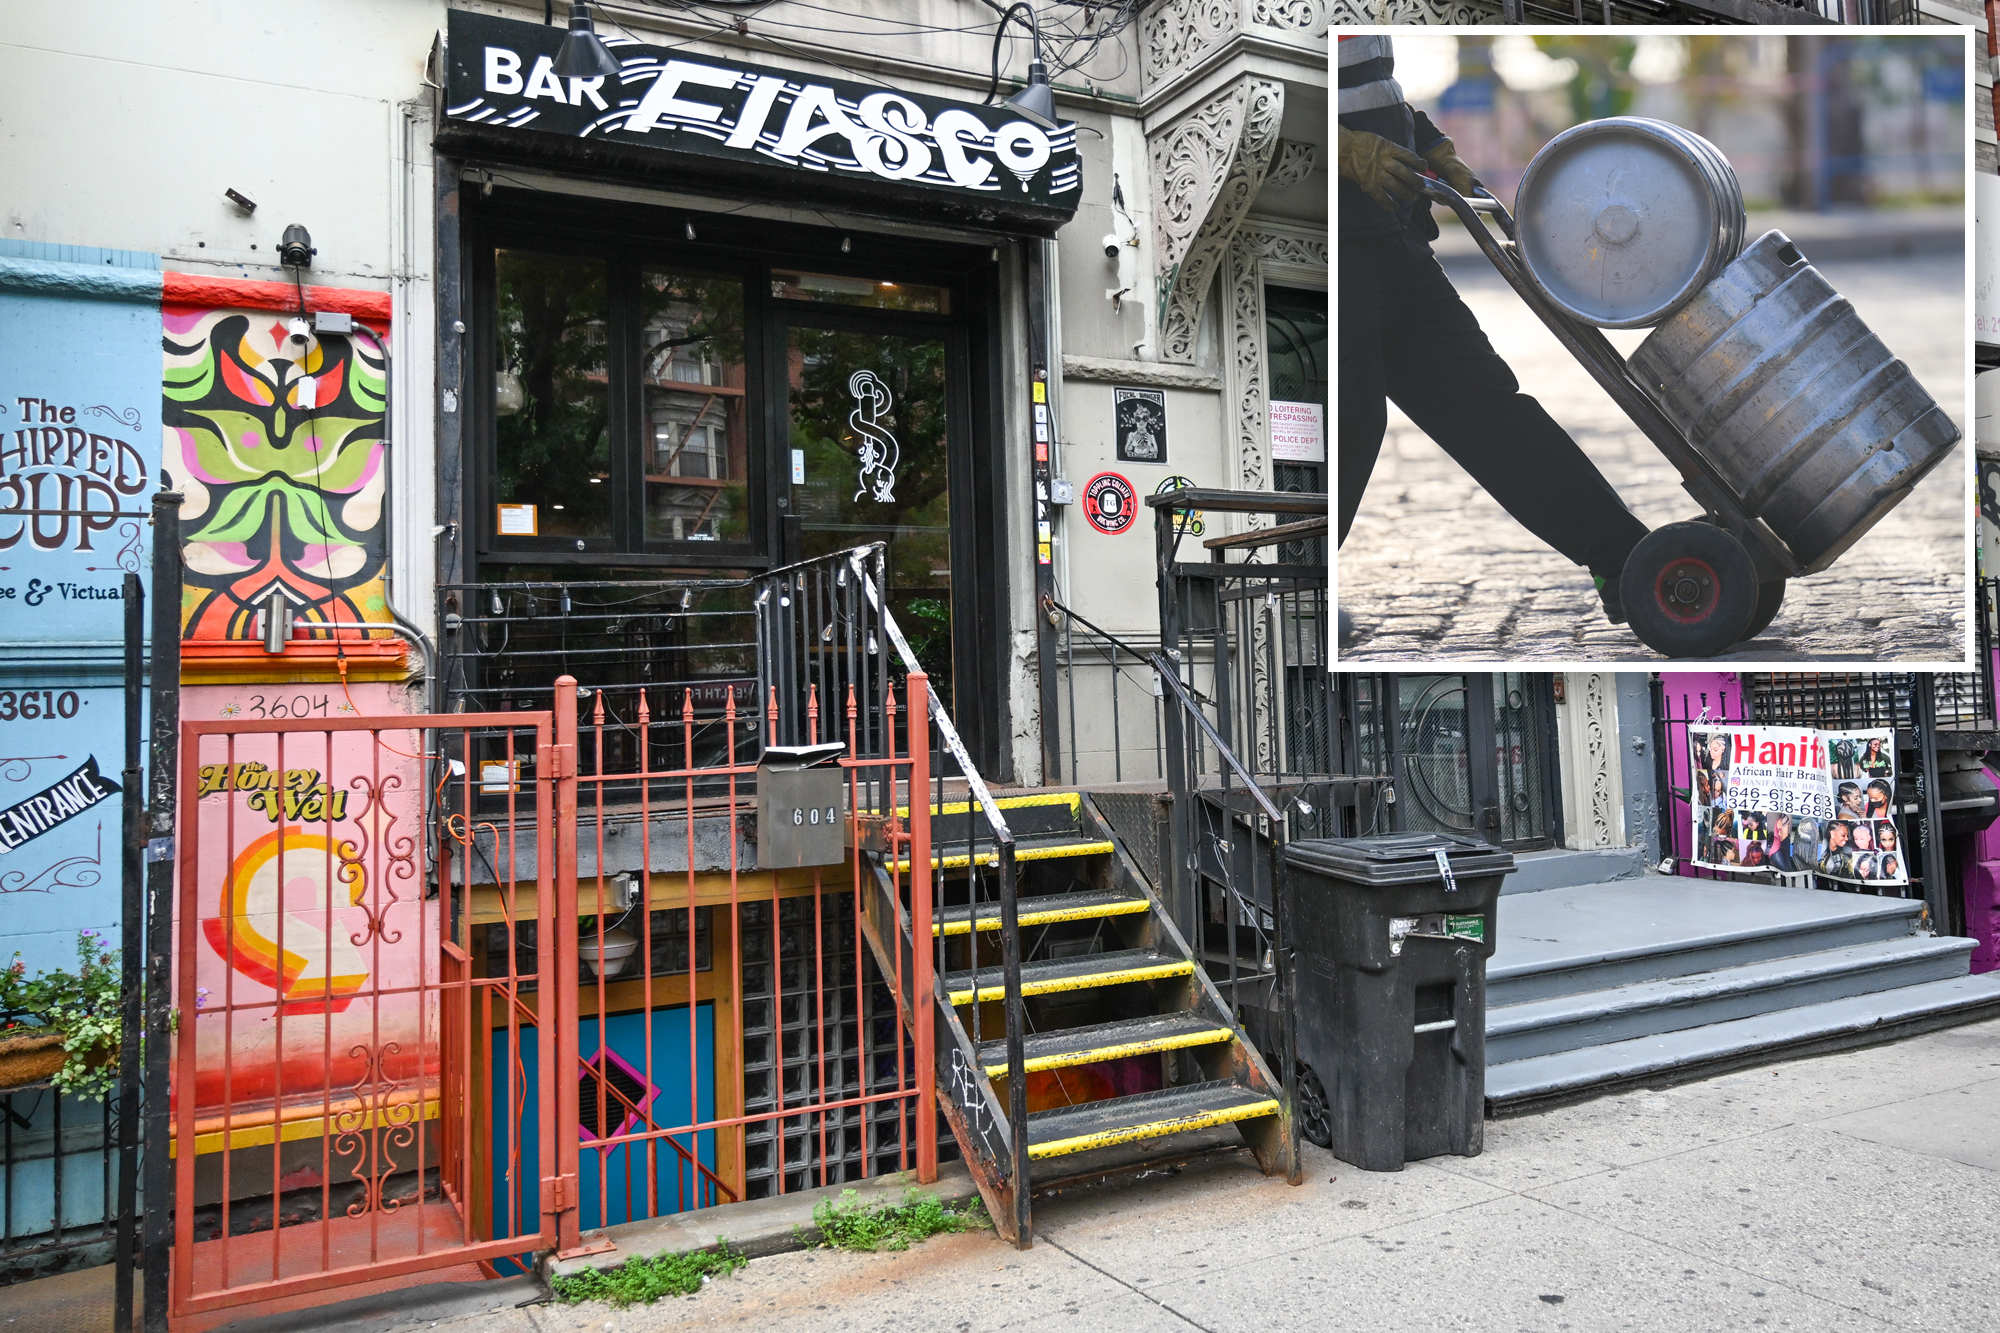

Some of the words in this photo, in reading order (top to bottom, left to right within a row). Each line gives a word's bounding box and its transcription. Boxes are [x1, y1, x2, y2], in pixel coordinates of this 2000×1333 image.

[484, 46, 609, 111] BAR
[623, 60, 1051, 187] FIASCO
[17, 397, 76, 425] The
[1270, 413, 1318, 423] TRESPASSING
[1275, 405, 1312, 415] LOITERING
[1273, 434, 1299, 443] POLICE
[1089, 478, 1111, 497] TOPPLING
[1112, 479, 1131, 499] GOLIATH
[1106, 499, 1116, 507] TG
[1096, 515, 1119, 527] BREWING
[25, 578, 53, 606] &
[0, 691, 79, 720] 3610
[250, 695, 329, 719] 3604
[1733, 734, 1827, 771] Hanifa
[199, 763, 321, 800] Honey
[1733, 766, 1772, 777] African
[1776, 767, 1794, 779] Hair
[1729, 787, 1832, 807] 646-673-763
[0, 768, 107, 848] ENTRANCE
[793, 807, 836, 826] 604
[1729, 798, 1833, 819] 347-388-686
